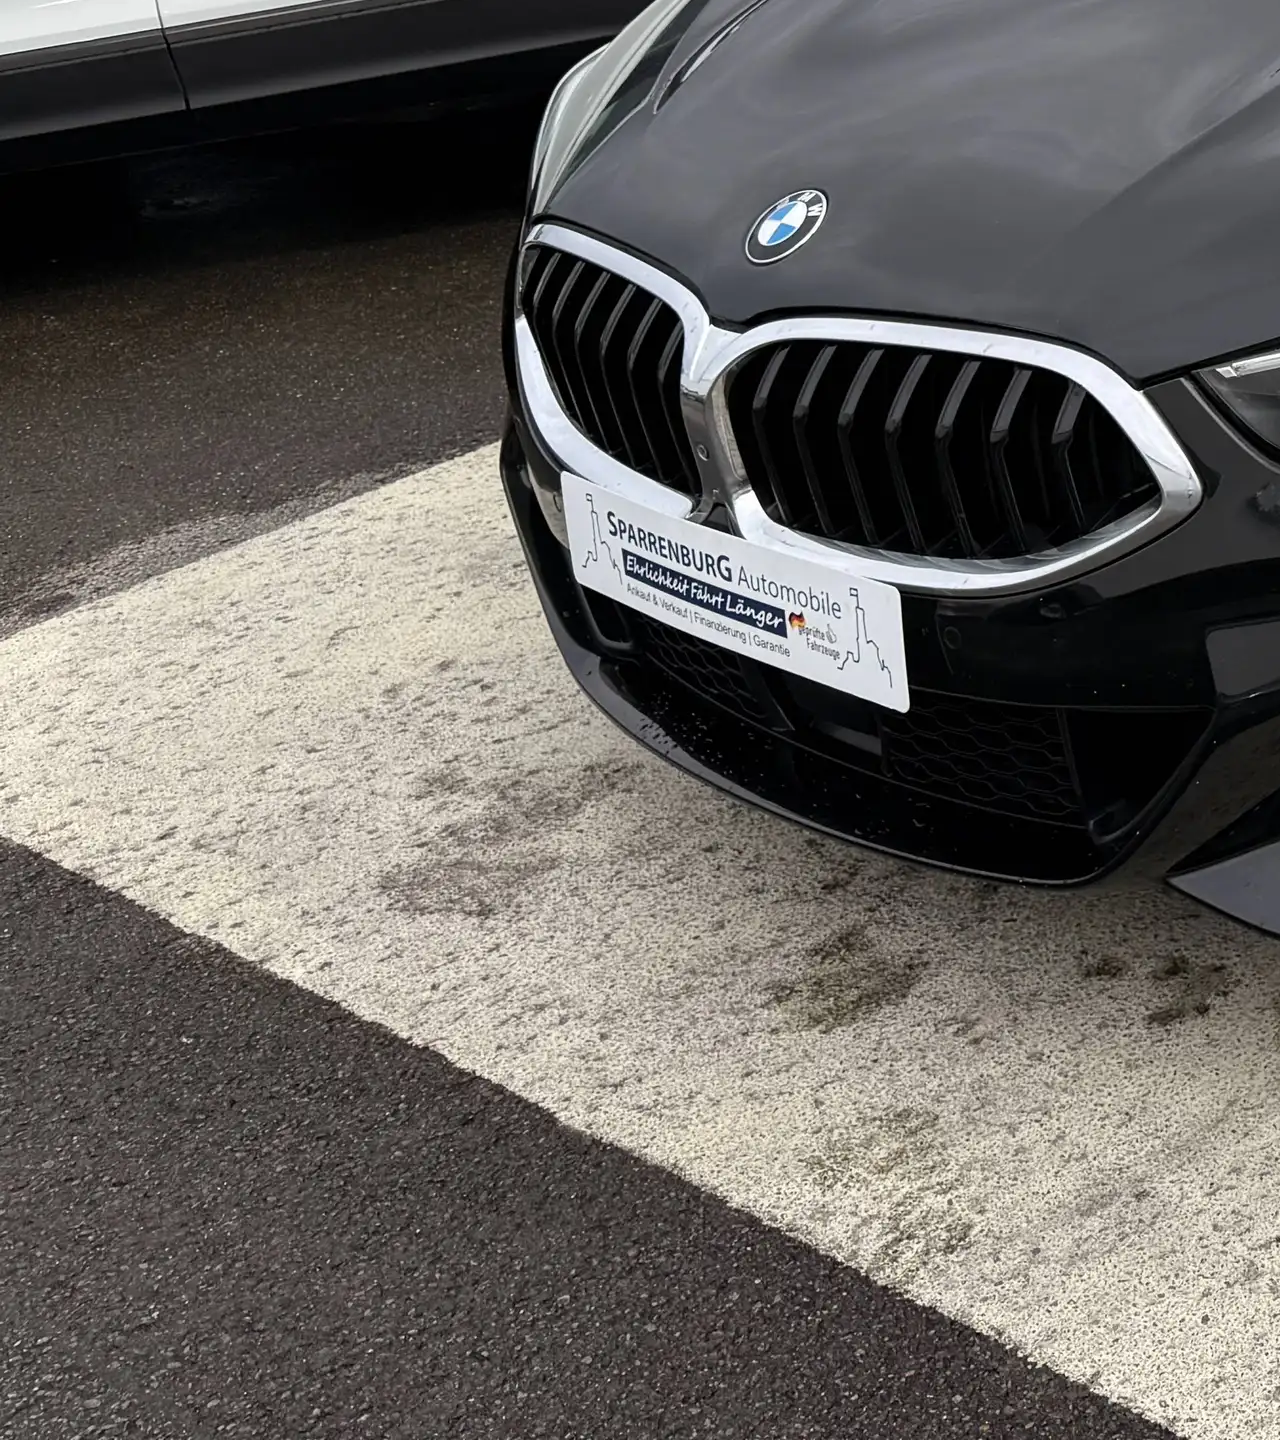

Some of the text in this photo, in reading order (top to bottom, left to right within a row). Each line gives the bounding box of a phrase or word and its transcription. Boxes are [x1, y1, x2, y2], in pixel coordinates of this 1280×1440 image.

[607, 511, 841, 619] SPARRENBURG Automobile
[626, 555, 783, 629] Ehrlichkeit Fährt Länger
[659, 598, 688, 618] Verkauf
[694, 611, 746, 644] Finanzierung
[753, 635, 790, 657] Garantie
[807, 638, 840, 660] Fahrzeuge
